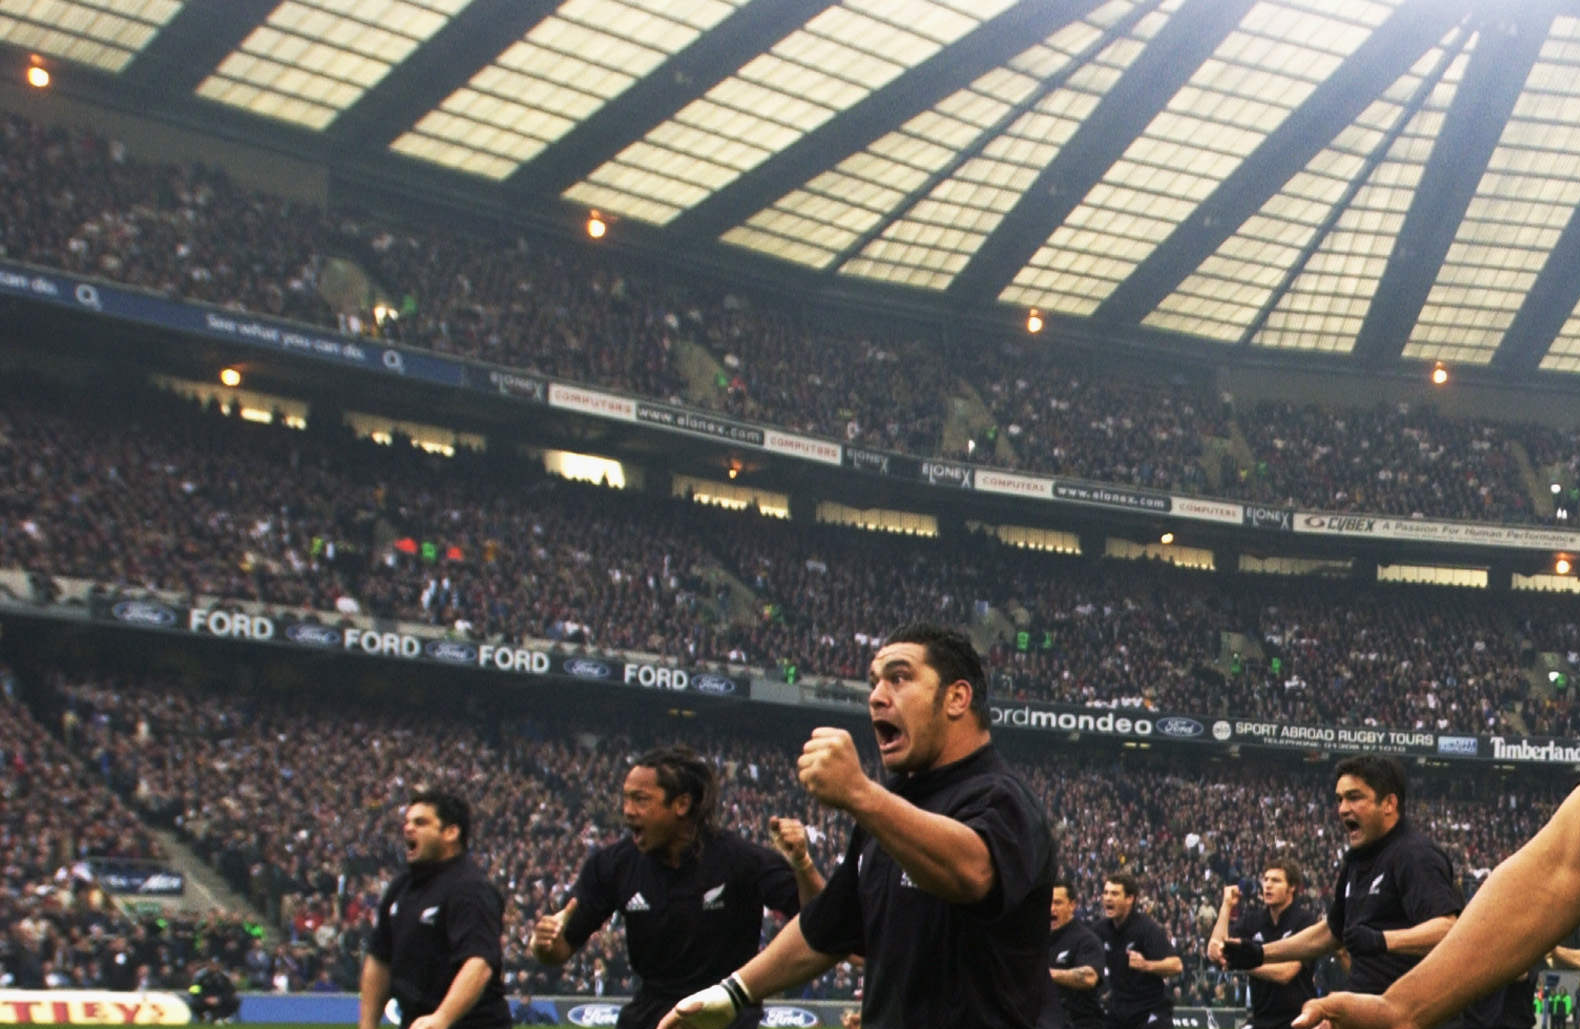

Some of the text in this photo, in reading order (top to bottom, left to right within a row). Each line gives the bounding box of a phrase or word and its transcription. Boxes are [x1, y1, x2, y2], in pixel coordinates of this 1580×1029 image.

[982, 474, 1046, 493] COMPUTERS
[1057, 484, 1165, 509] www.elonex.com
[1179, 502, 1237, 519] COMPUTERS
[1327, 515, 1376, 533] CYBEX
[189, 607, 275, 640] FORD
[344, 628, 421, 659] FORD
[479, 645, 549, 674] FORD
[624, 663, 689, 691] FORD
[990, 706, 1152, 735] ordmondeo
[1236, 721, 1434, 746] SPORT ABROAD RUGBY TOURS
